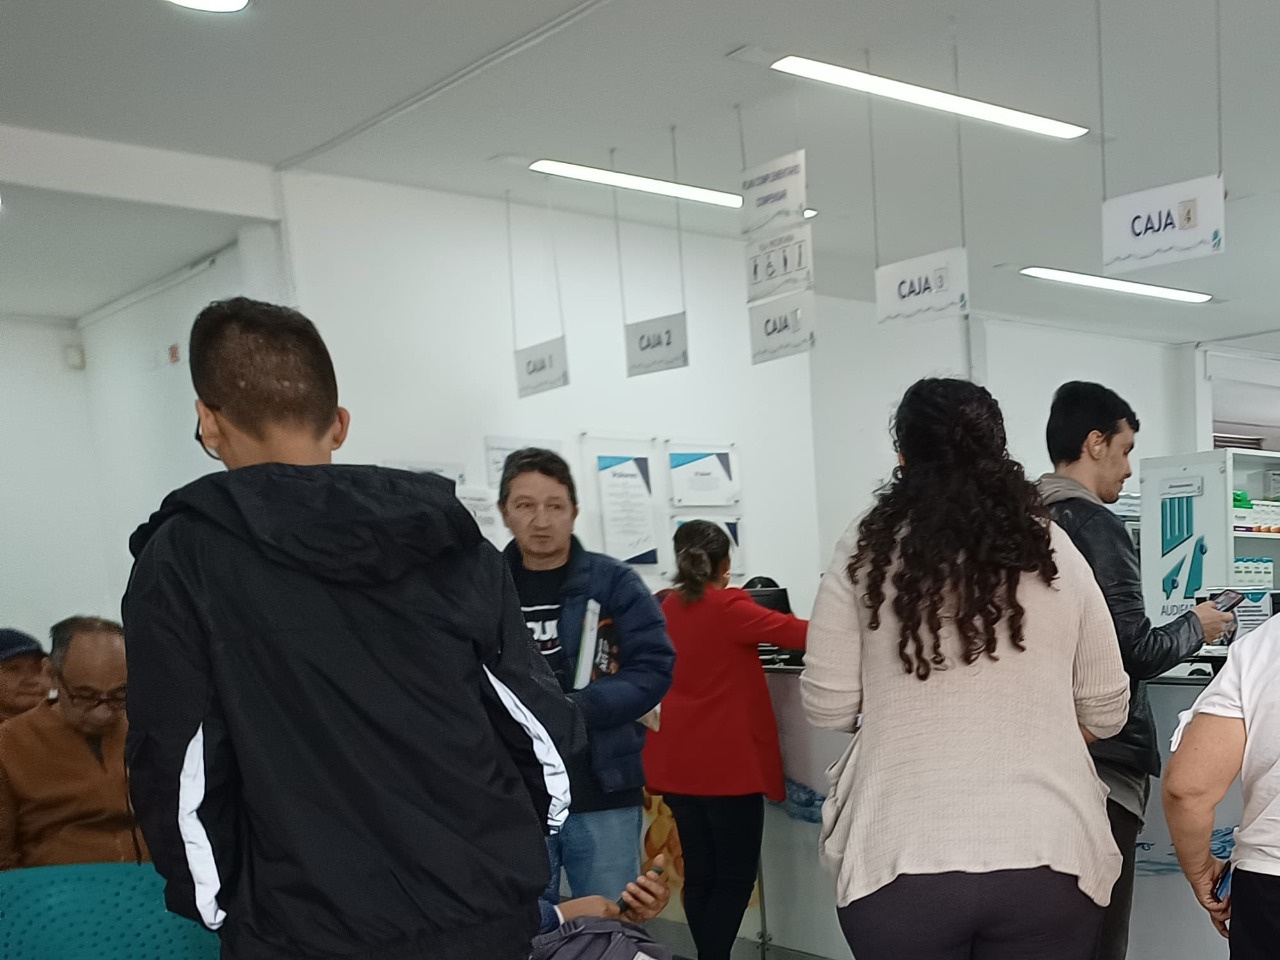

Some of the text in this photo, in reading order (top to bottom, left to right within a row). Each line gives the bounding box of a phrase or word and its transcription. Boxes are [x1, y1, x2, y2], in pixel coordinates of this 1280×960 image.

[1131, 208, 1177, 237] CAJA
[897, 275, 932, 300] CAJA
[763, 314, 790, 337] CAJA
[638, 329, 673, 352] CAJA 2
